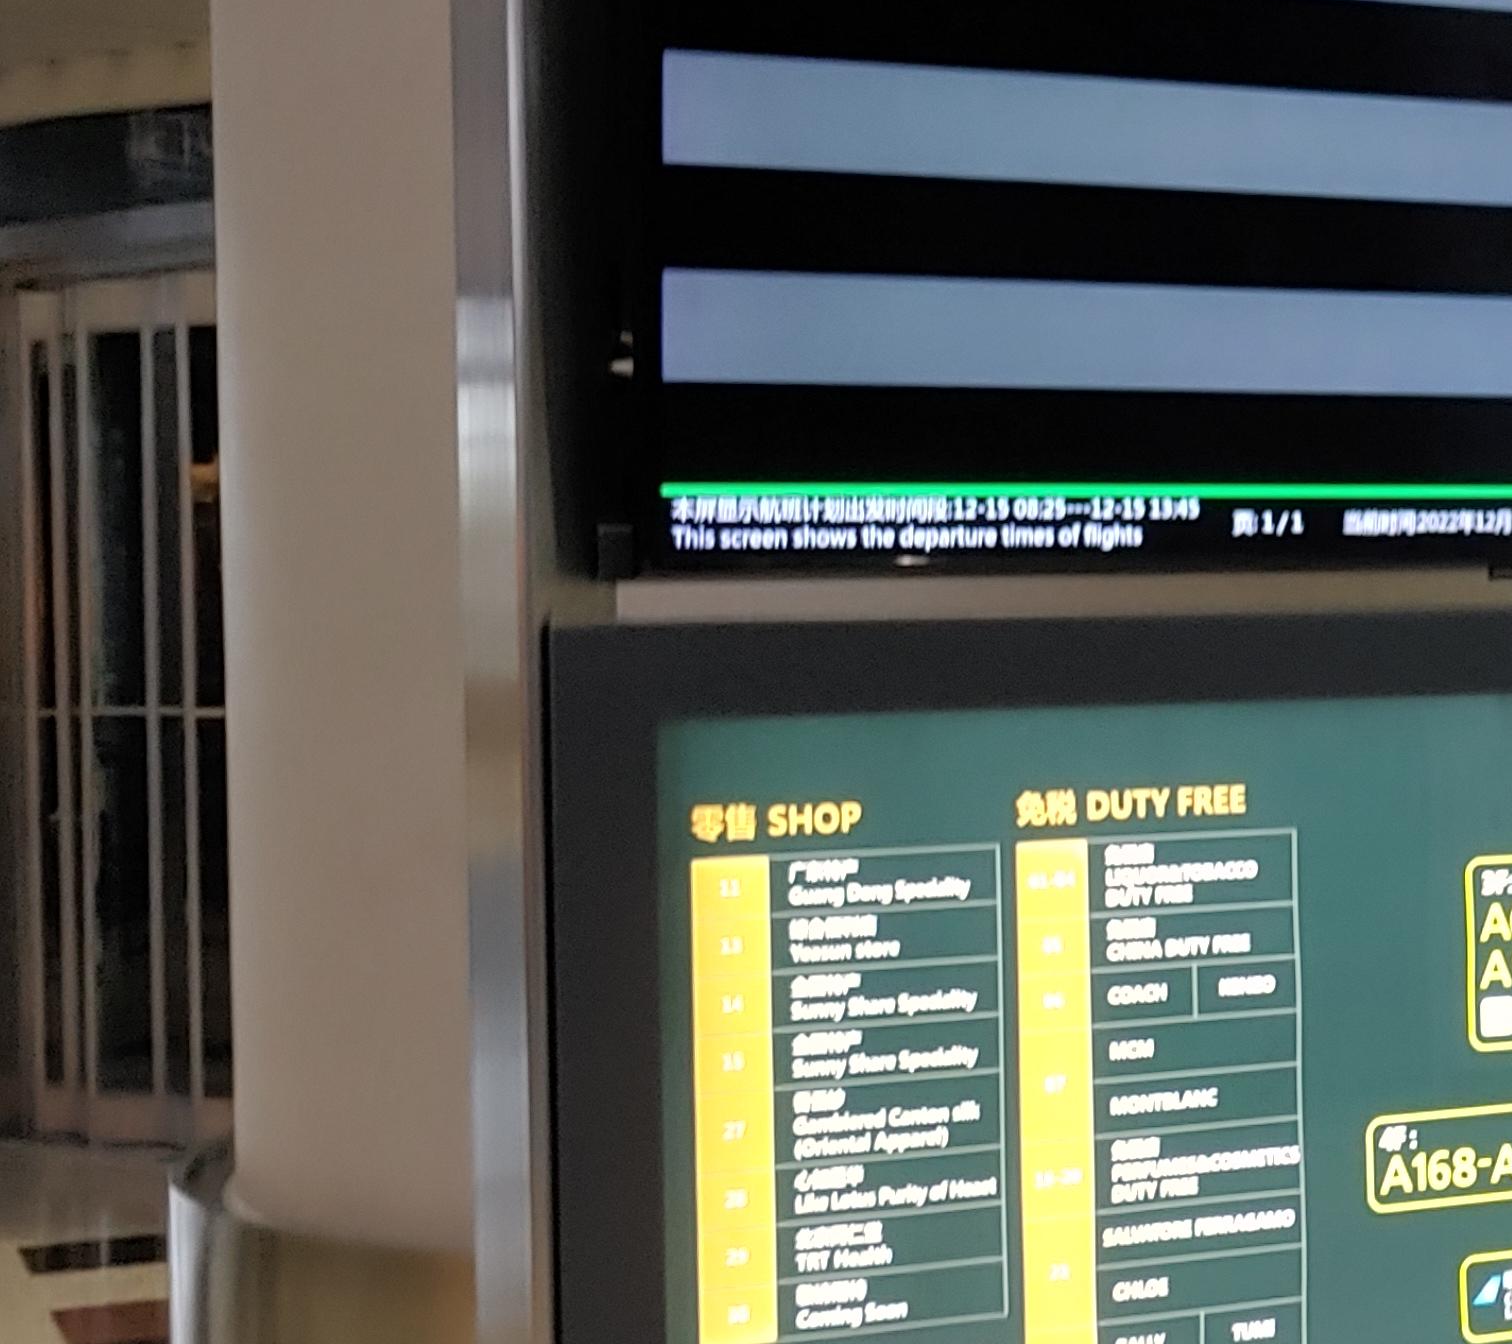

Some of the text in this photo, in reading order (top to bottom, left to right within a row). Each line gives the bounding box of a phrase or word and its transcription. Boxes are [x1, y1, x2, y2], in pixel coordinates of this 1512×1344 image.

[671, 522, 1144, 553] This screen shows the departure times of flights
[1086, 786, 1171, 822] DUTY
[1177, 783, 1247, 816] FREE
[767, 800, 862, 837] SHOP
[1104, 882, 1195, 908] DUTY FREE
[1106, 932, 1251, 963] CHINA DUTY FREE
[1107, 982, 1168, 1006] COACH
[1109, 1037, 1155, 1061] MCM
[1109, 1086, 1219, 1117] MONTBLANC
[1111, 1174, 1200, 1205] DUTY FREE
[1103, 1208, 1297, 1248] SALVATORE FERRAGAMO
[1112, 1276, 1170, 1303] CHLOE
[795, 1306, 863, 1330] Coming
[1231, 1317, 1277, 1343] TUMI
